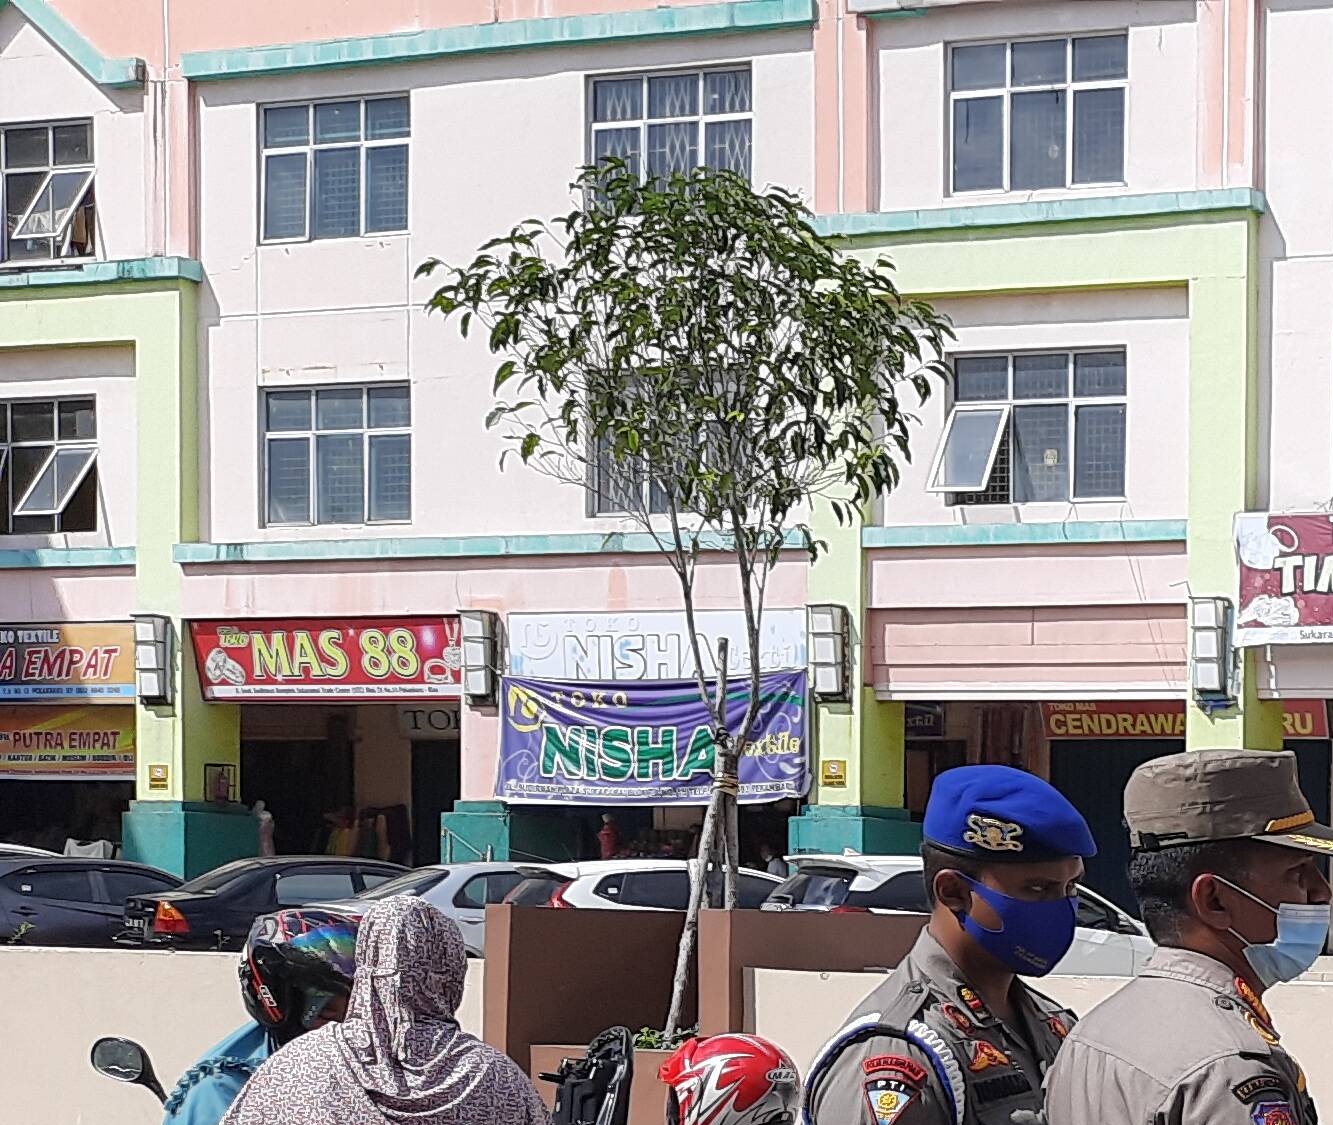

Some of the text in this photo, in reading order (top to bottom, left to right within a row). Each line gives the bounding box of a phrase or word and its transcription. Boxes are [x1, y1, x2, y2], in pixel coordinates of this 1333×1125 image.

[0, 629, 60, 644] KO TEXTILE
[22, 646, 121, 681] EMPAT
[249, 626, 421, 680] MAS 88
[562, 633, 720, 680] NISHA
[551, 690, 628, 708] TOKO
[1048, 712, 1314, 737] CENDRAWA RU
[12, 731, 65, 751] PUTRA
[68, 731, 121, 750] EMPAT
[539, 724, 801, 782] NISHA extile
